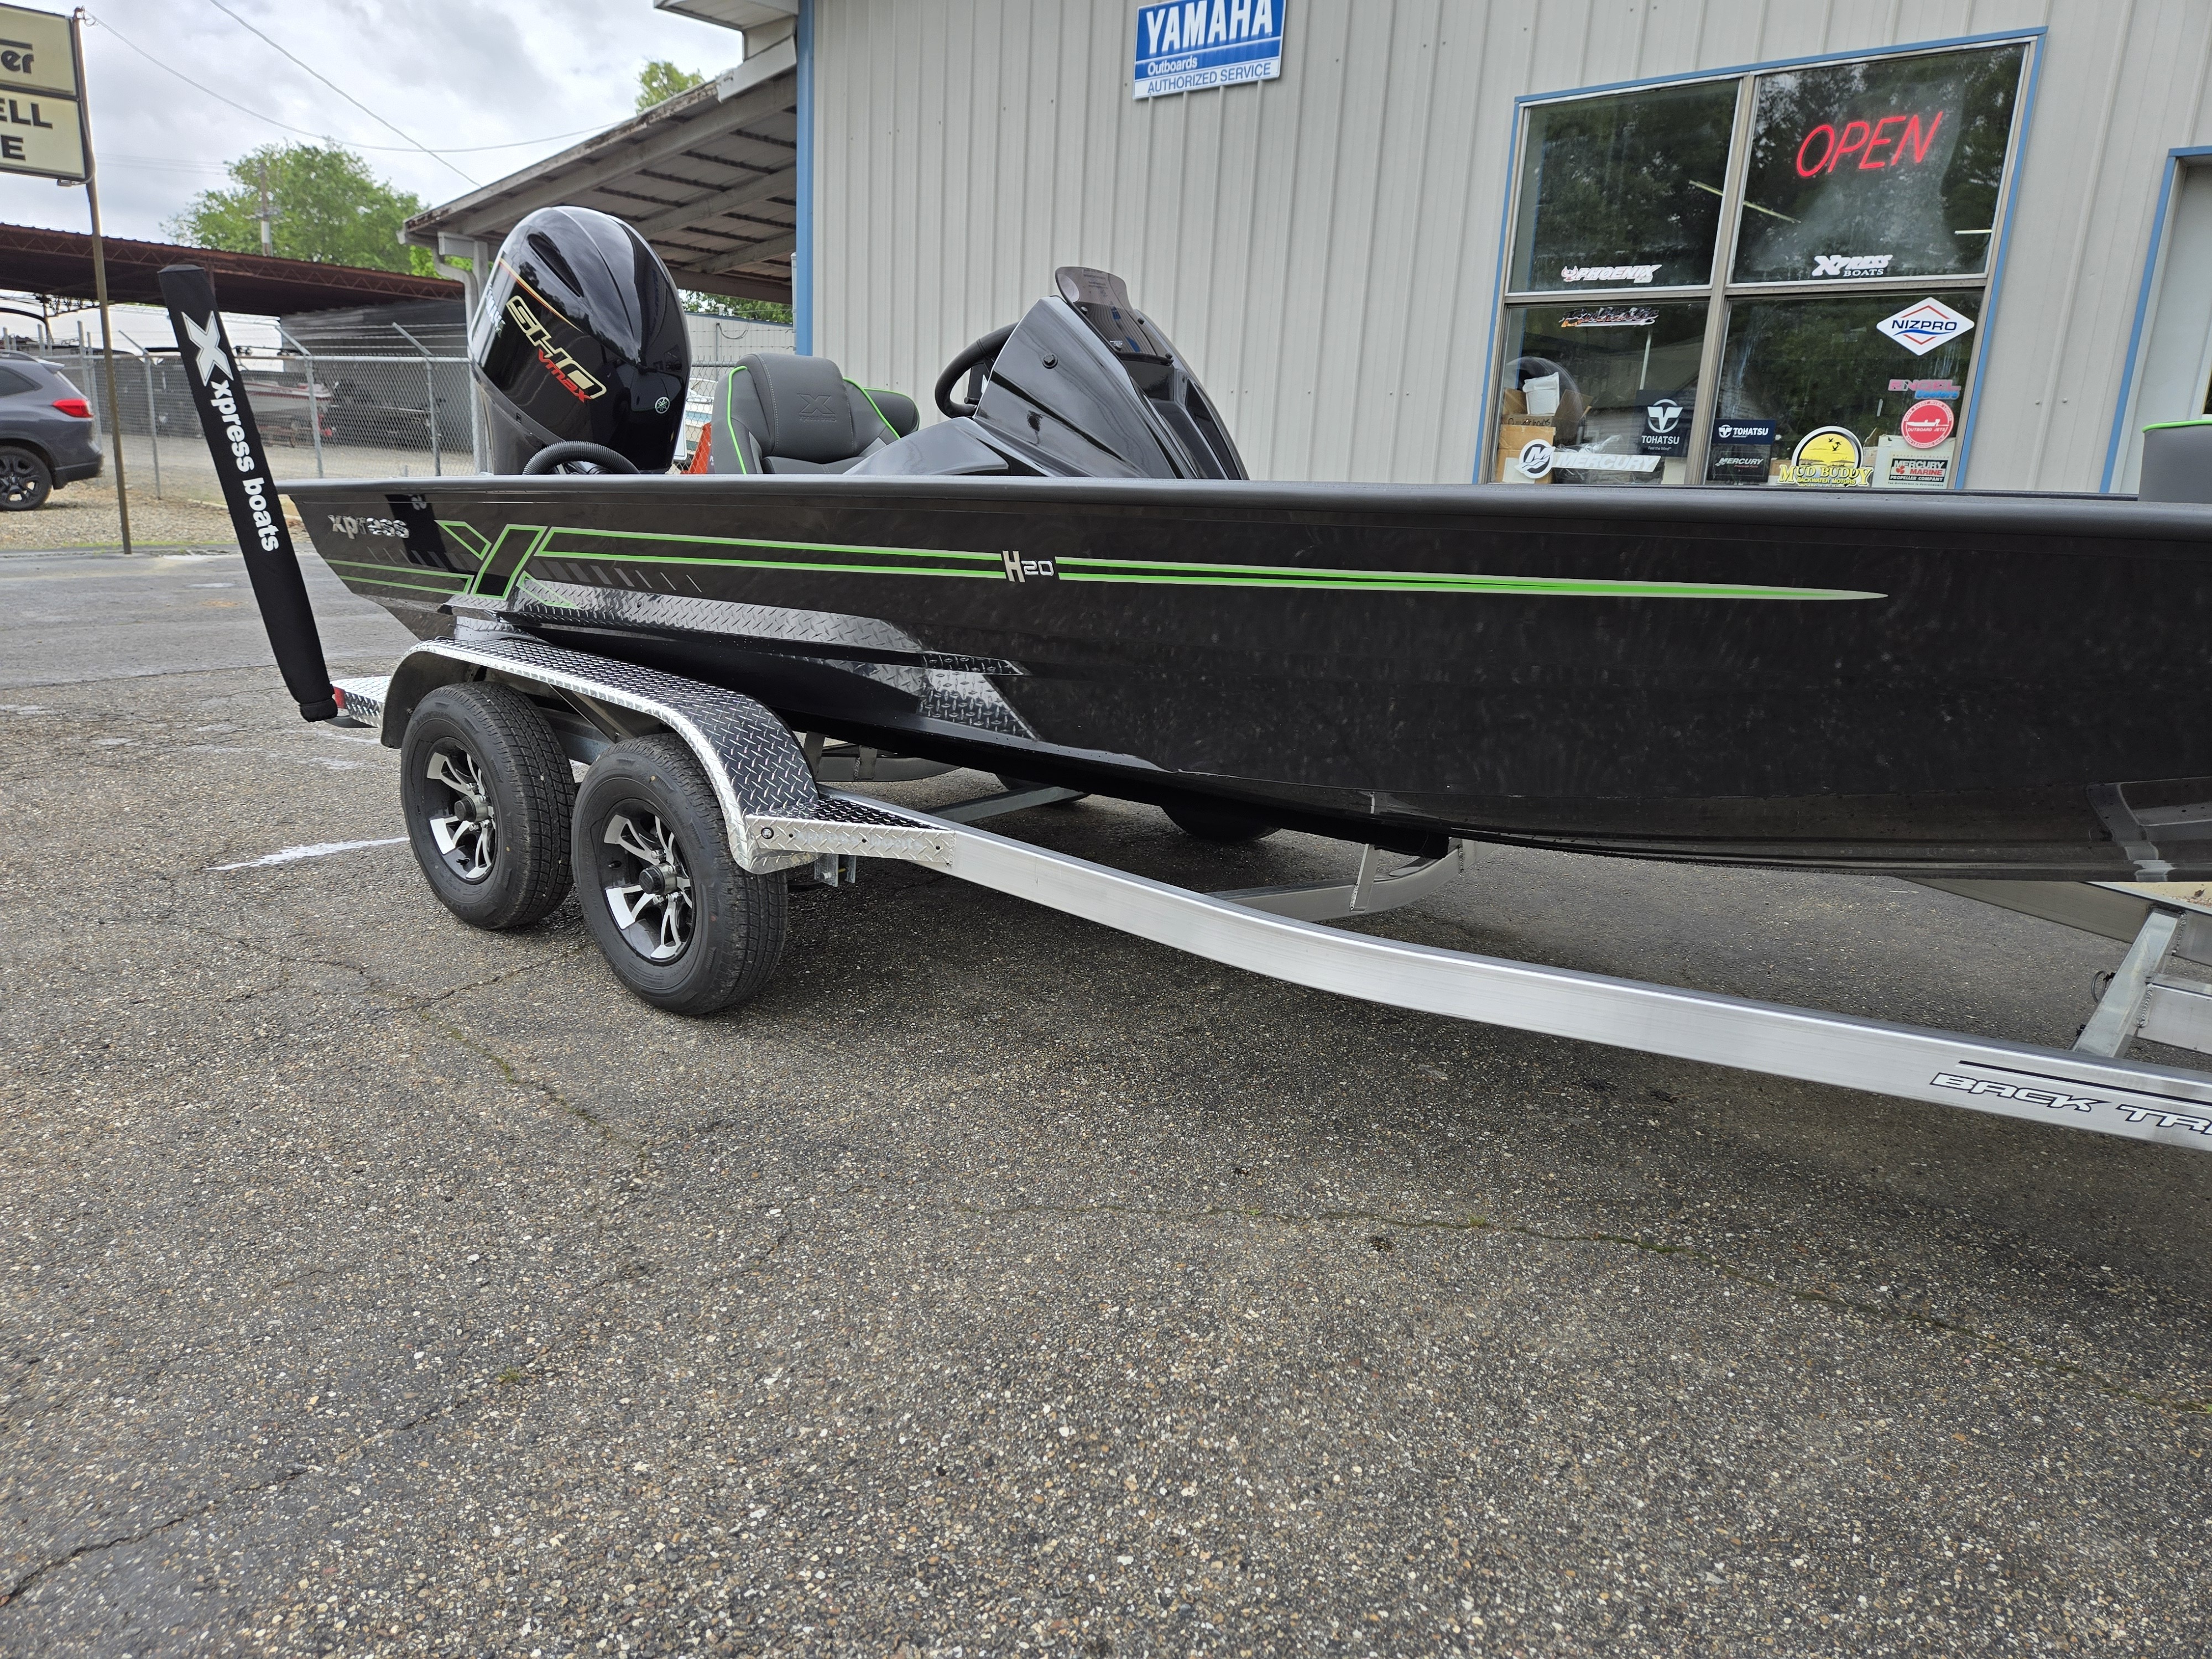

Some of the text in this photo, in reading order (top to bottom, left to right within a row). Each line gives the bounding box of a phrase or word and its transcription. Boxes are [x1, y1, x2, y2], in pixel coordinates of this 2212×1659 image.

[1146, 0, 1273, 55] YAMAHA
[1147, 55, 1198, 76] Outboards
[1147, 62, 1272, 93] AUTHORIZED SERVICE
[1797, 111, 1943, 177] OPEN
[1577, 264, 1662, 280] PHOENIX
[1891, 320, 1958, 331] NIZPRO
[1641, 435, 1680, 445] TOHATSU
[211, 380, 254, 472] xpress
[242, 477, 279, 551] boats
[1556, 454, 1657, 471] MERCURY
[1893, 460, 1945, 469] MERCURY
[1779, 465, 1874, 486] MUD BUDDY
[327, 514, 409, 539] xpress
[1003, 550, 1054, 583] H20
[869, 832, 924, 849] boats
[1929, 1072, 2212, 1135] BACK TR
